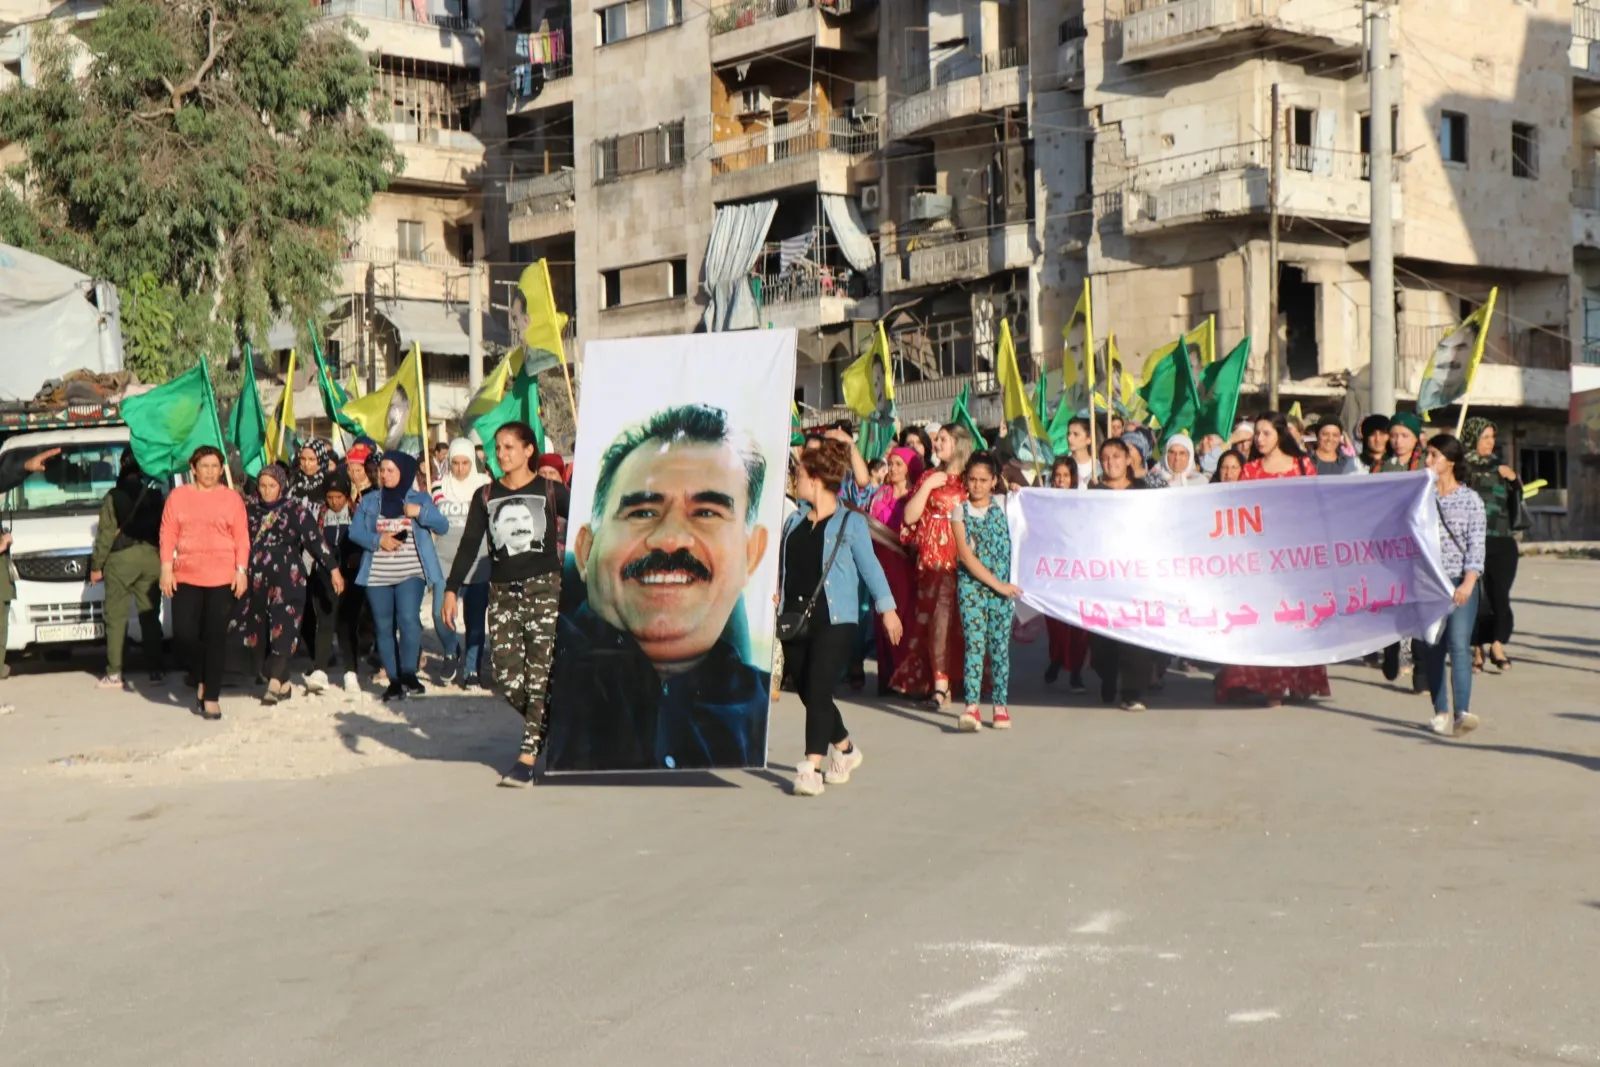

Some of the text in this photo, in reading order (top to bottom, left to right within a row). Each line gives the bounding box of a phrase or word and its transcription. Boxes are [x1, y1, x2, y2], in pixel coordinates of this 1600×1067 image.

[1209, 505, 1263, 539] JIN
[1035, 555, 1149, 580] AZADIYE
[1156, 551, 1262, 578] SEROKE
[1268, 544, 1329, 572] XWE
[1178, 599, 1259, 635] حرية
[1273, 590, 1337, 629] تريد
